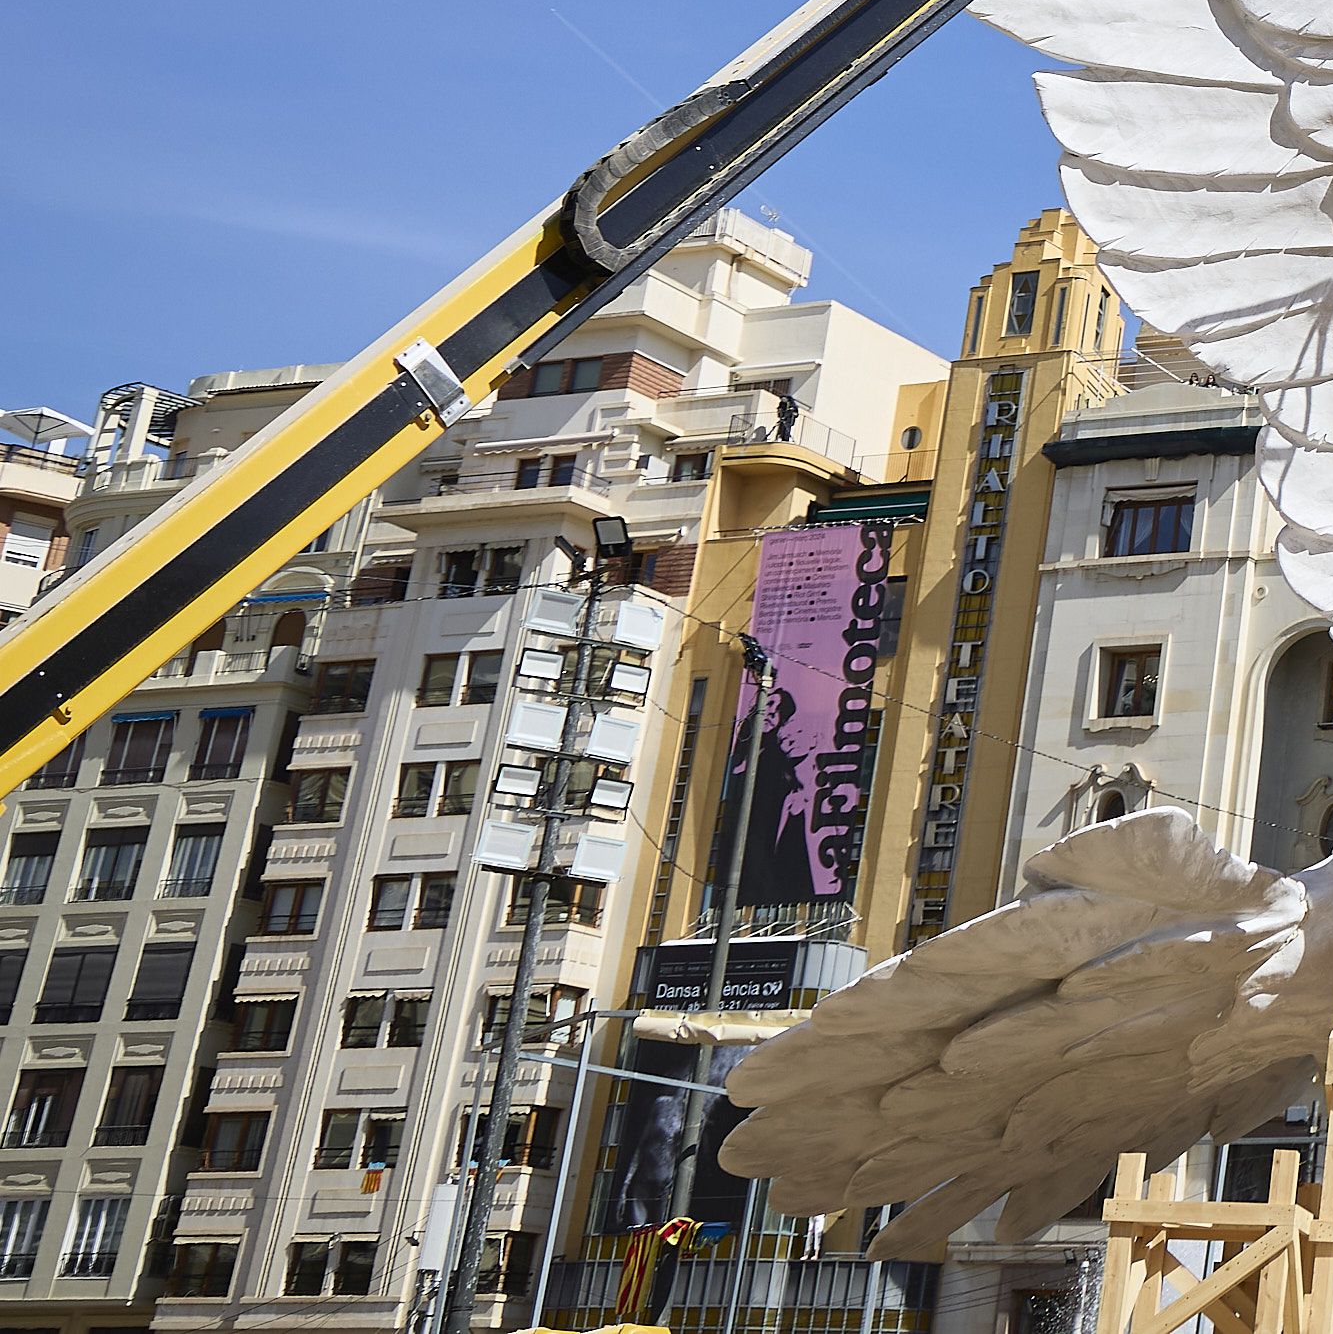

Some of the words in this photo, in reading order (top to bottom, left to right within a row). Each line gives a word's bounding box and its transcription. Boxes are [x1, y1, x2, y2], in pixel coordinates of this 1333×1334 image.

[963, 400, 1017, 594] RIALTO
[923, 641, 984, 848] TEATRE
[656, 983, 701, 998] Dansa
